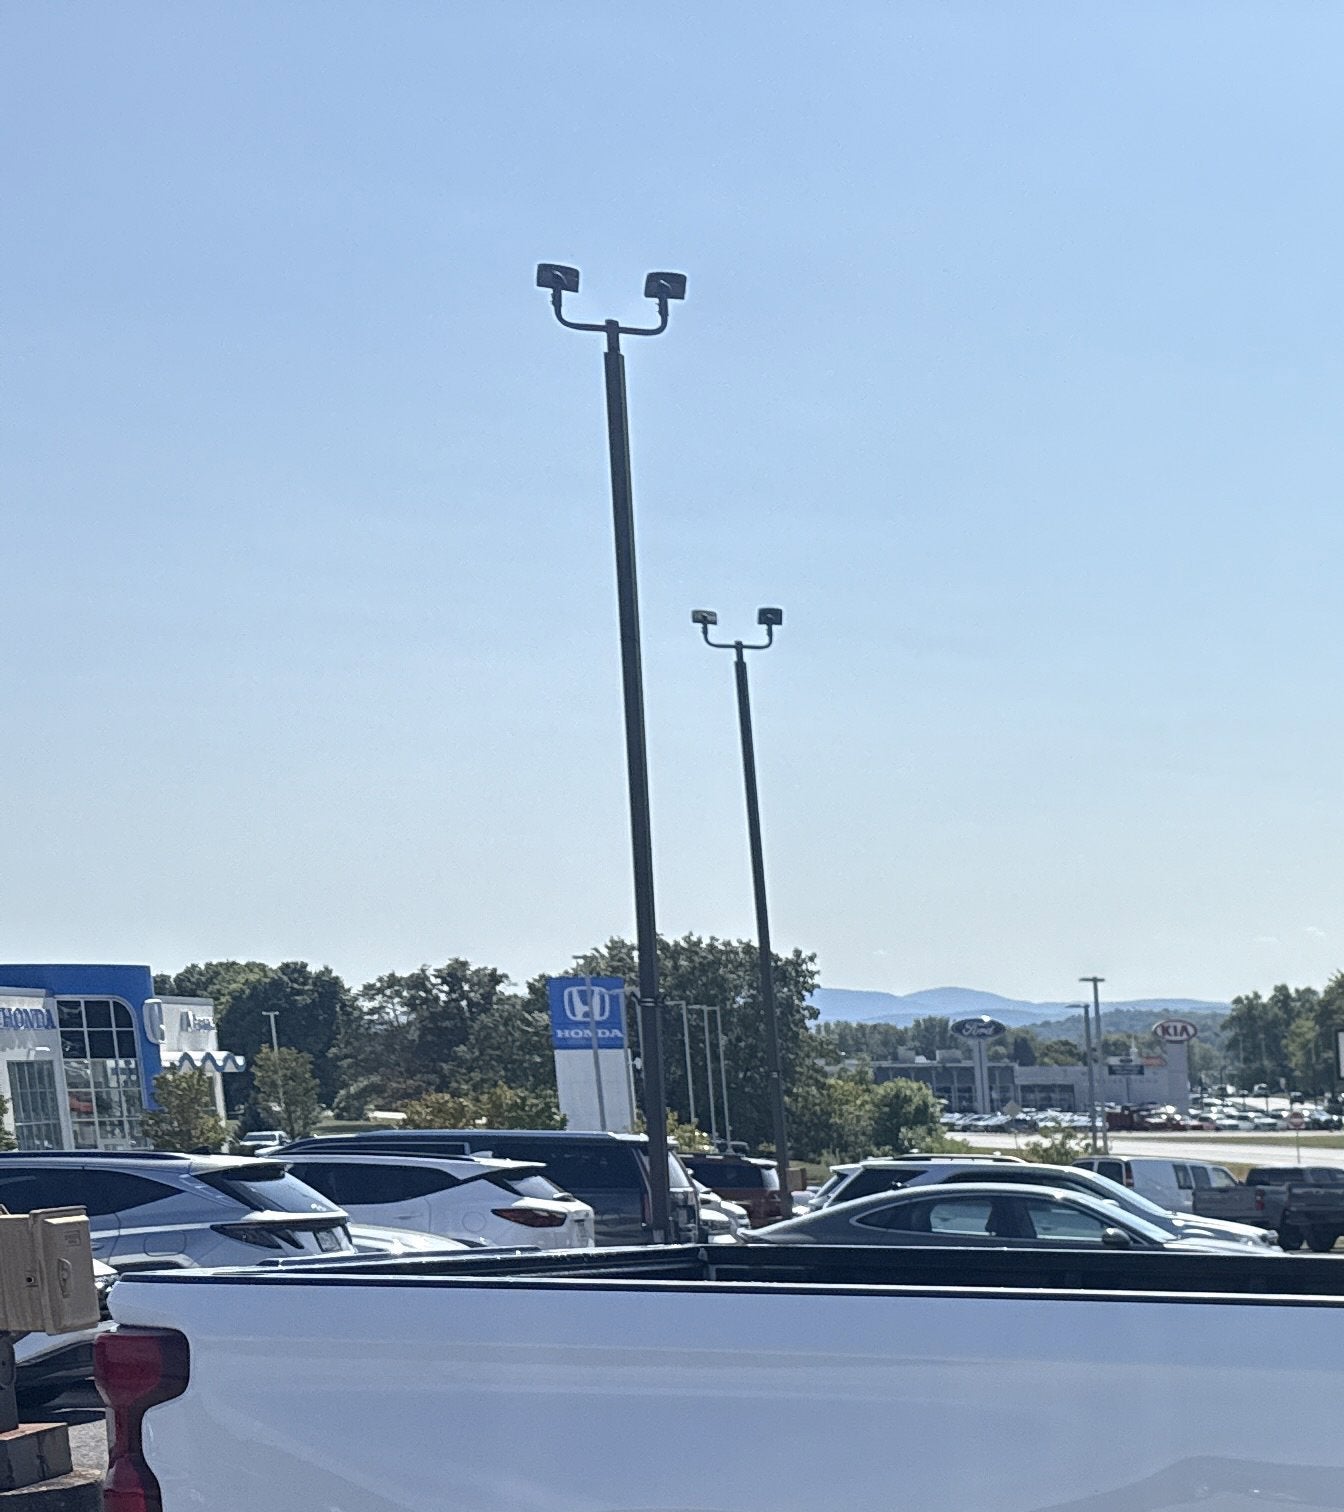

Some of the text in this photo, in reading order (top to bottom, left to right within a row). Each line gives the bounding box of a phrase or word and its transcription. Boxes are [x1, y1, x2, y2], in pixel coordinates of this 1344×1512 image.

[3, 1007, 57, 1029] HONDA
[555, 1028, 625, 1039] HONDA
[1160, 1024, 1191, 1038] KIA
